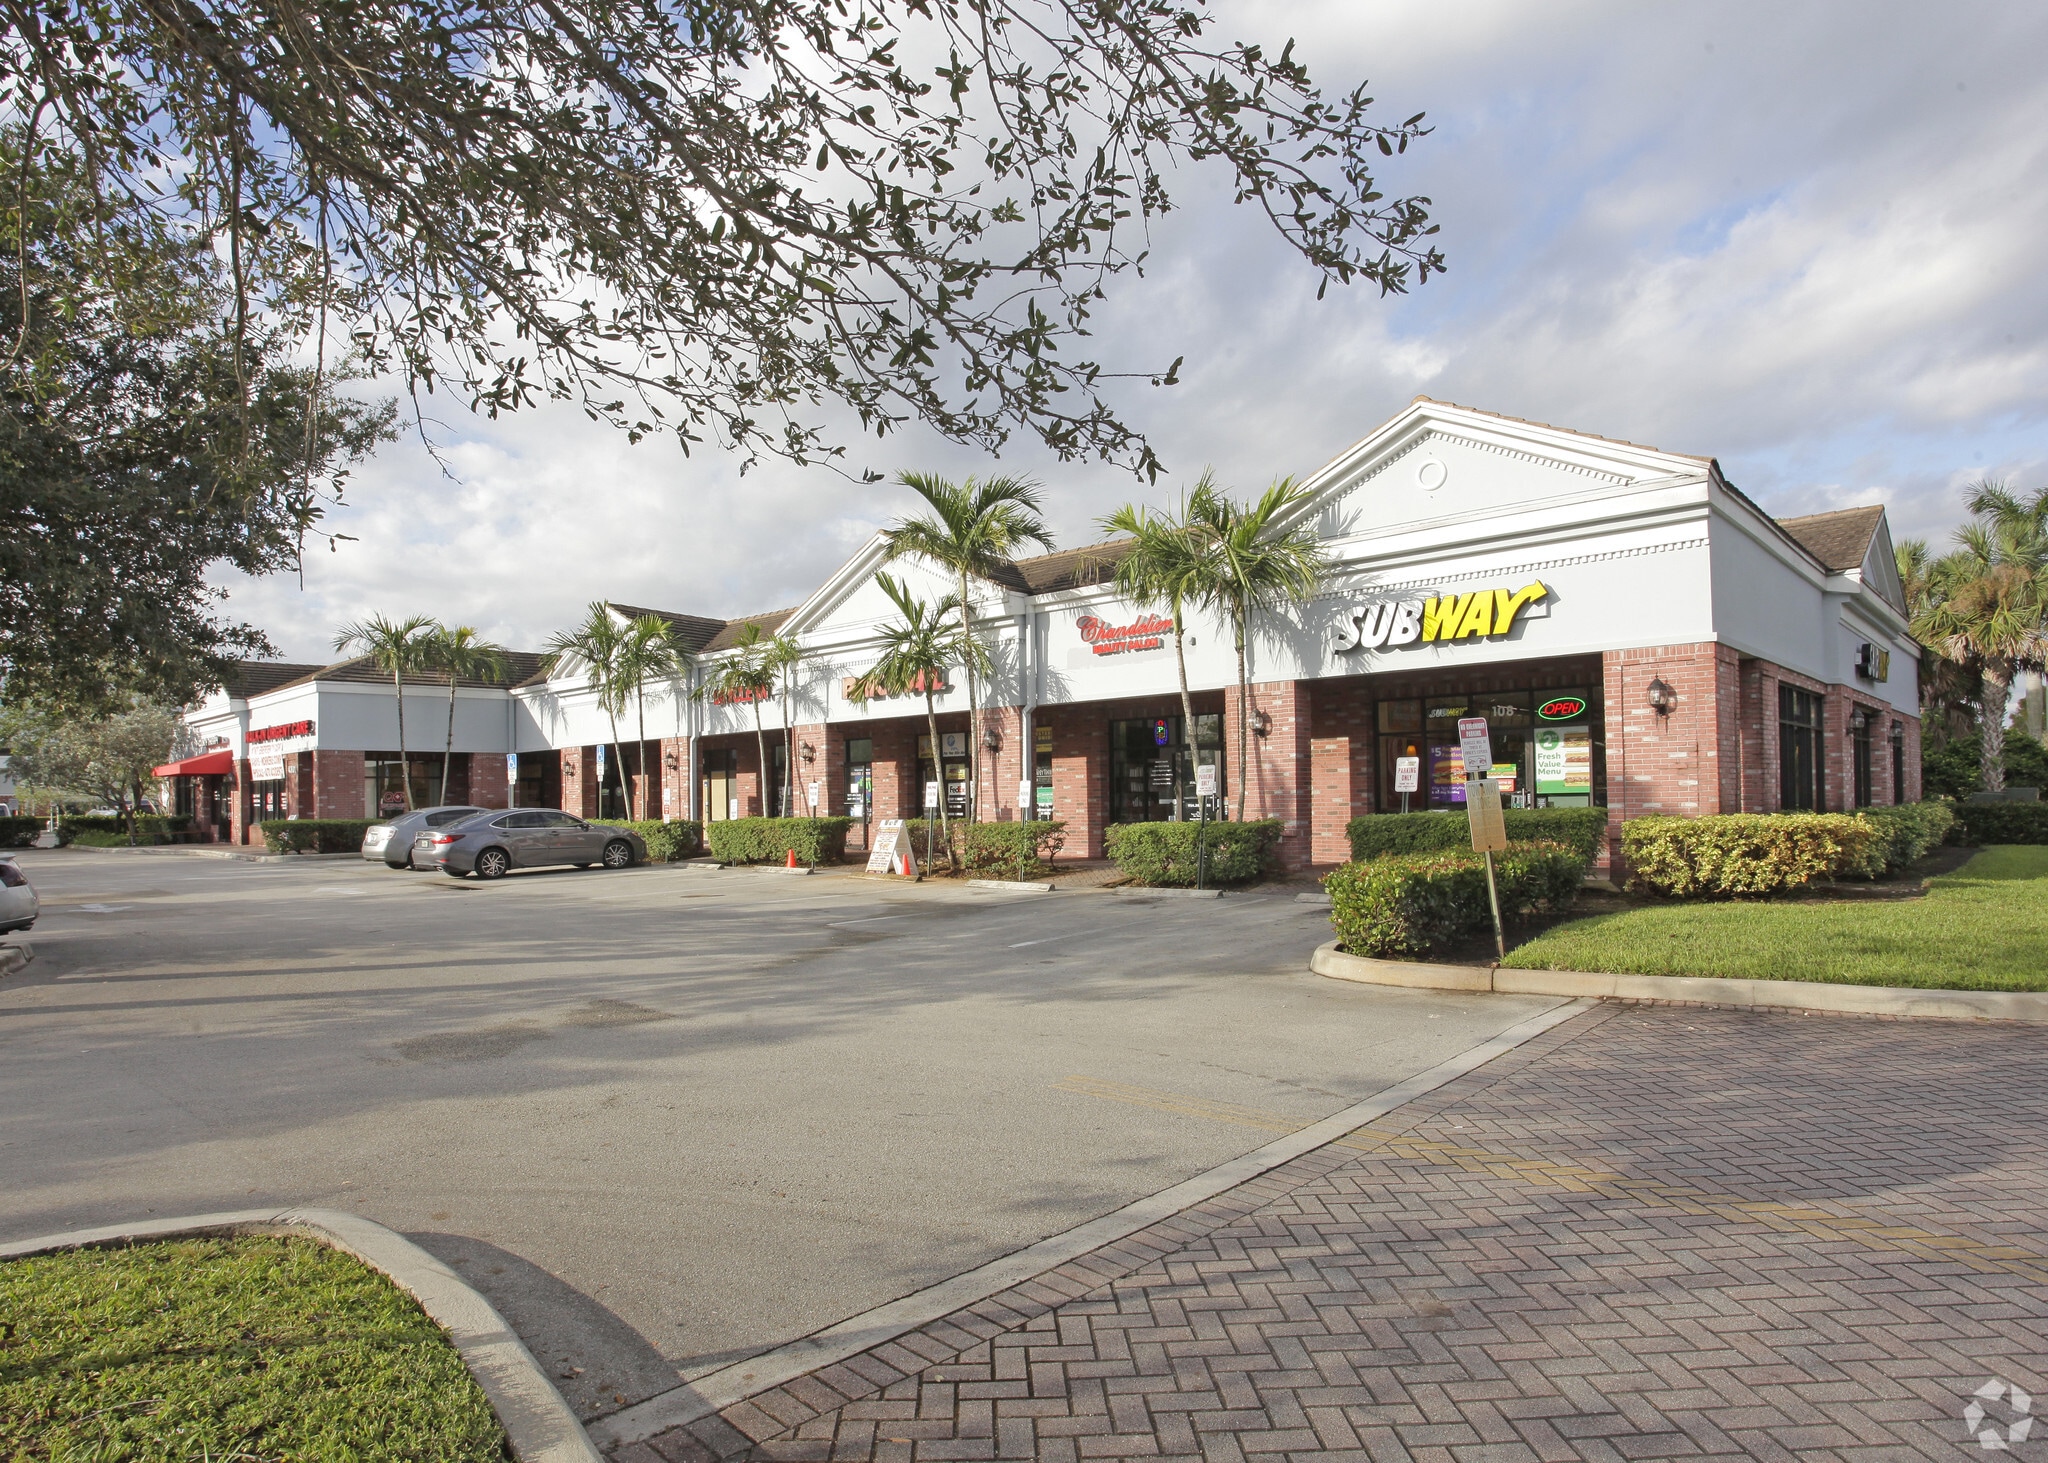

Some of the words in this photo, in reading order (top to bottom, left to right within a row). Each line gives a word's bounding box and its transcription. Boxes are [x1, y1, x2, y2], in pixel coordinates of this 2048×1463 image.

[1331, 579, 1548, 652] SUBWAY
[1076, 613, 1173, 642] Chandelier
[1093, 642, 1126, 654] BEAUTY
[1127, 637, 1159, 650] SALON
[1429, 707, 1468, 718] SUBWAY
[1492, 705, 1514, 717] 108
[1544, 702, 1580, 715] OPEN
[291, 720, 309, 736] CARE
